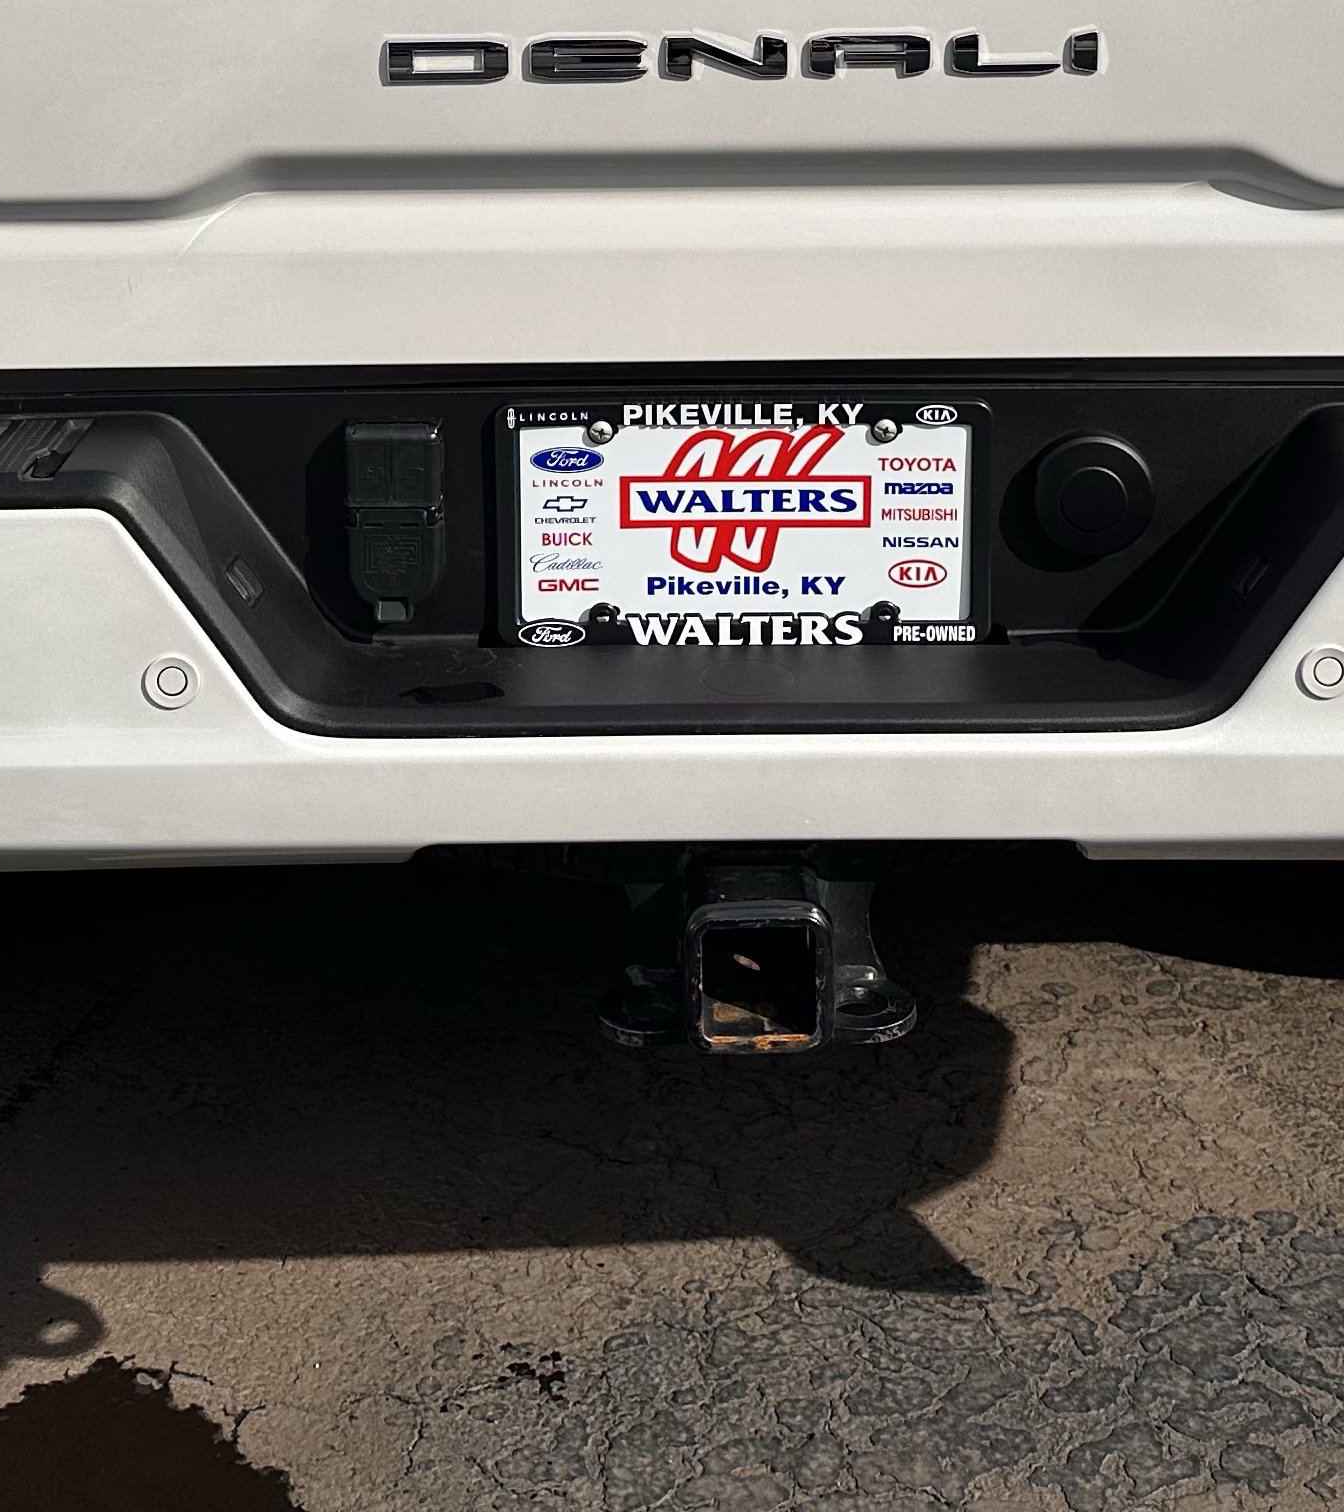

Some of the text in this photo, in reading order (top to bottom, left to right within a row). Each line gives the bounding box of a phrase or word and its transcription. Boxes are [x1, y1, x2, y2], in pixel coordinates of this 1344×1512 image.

[383, 29, 1102, 86] DENALI
[519, 411, 589, 421] LINCOLN
[623, 403, 863, 427] PIKEVILLE, KY
[546, 450, 589, 469] Ford
[878, 457, 956, 472] TOYOTA
[532, 479, 603, 487] LINCOLN
[636, 489, 857, 514] WALTERS
[535, 516, 597, 524] CHEVROLET
[881, 508, 957, 522] MITSUBISHI
[541, 533, 592, 547] BUICK
[883, 537, 958, 548] NISSAN
[530, 553, 603, 573] Cadillac
[899, 566, 937, 582] KIA
[538, 579, 599, 592] GMC
[647, 576, 846, 599] Pikeville, KY
[532, 626, 574, 644] Ford
[625, 614, 863, 646] WALTERS
[893, 626, 975, 642] PRE-OWNED
